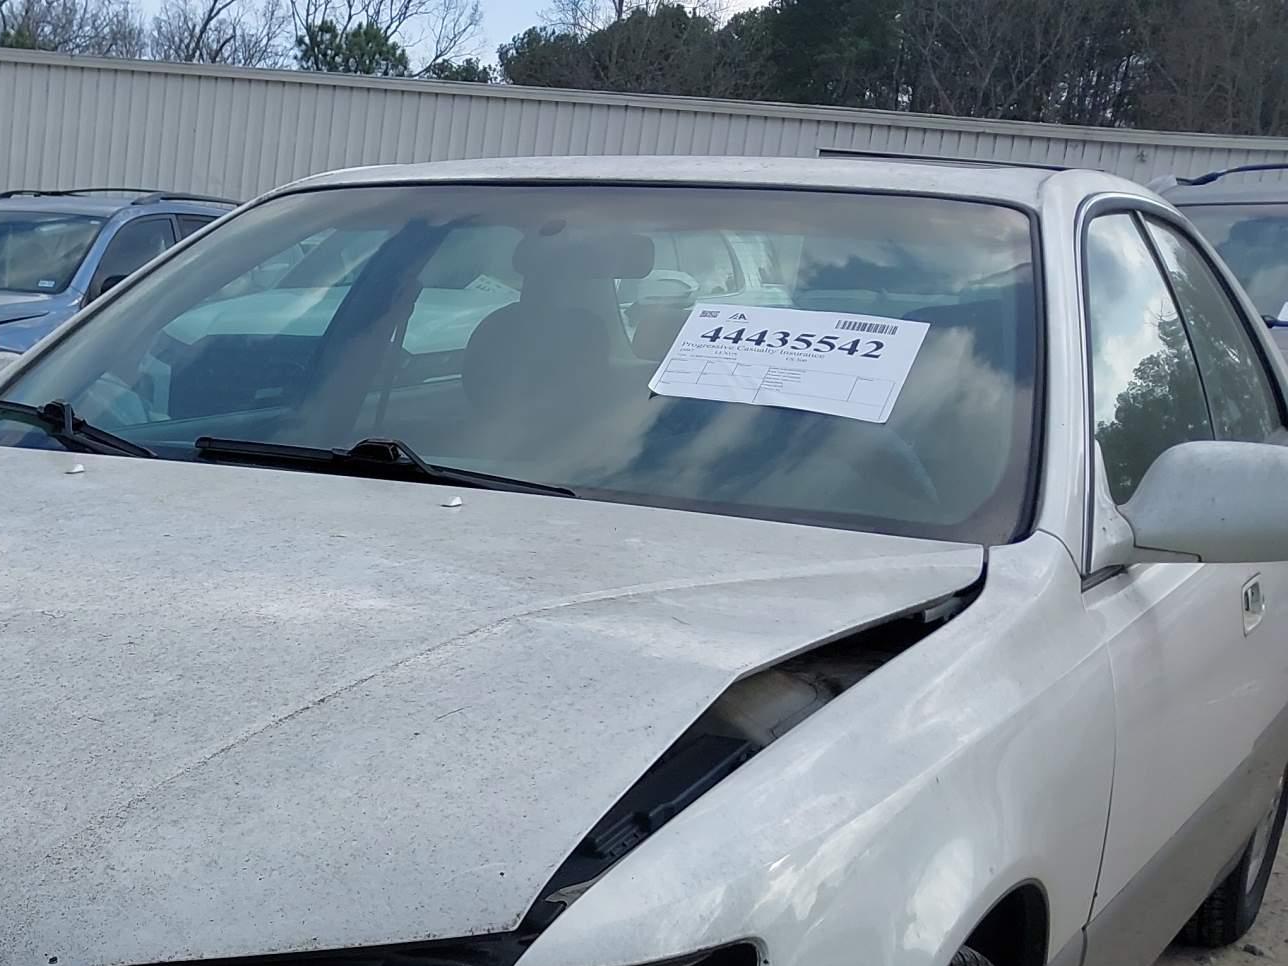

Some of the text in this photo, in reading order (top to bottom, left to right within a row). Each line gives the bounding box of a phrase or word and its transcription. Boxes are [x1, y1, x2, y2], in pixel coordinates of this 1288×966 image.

[681, 341, 826, 360] Progressive Casualty Insurance
[700, 326, 884, 359] 44435542
